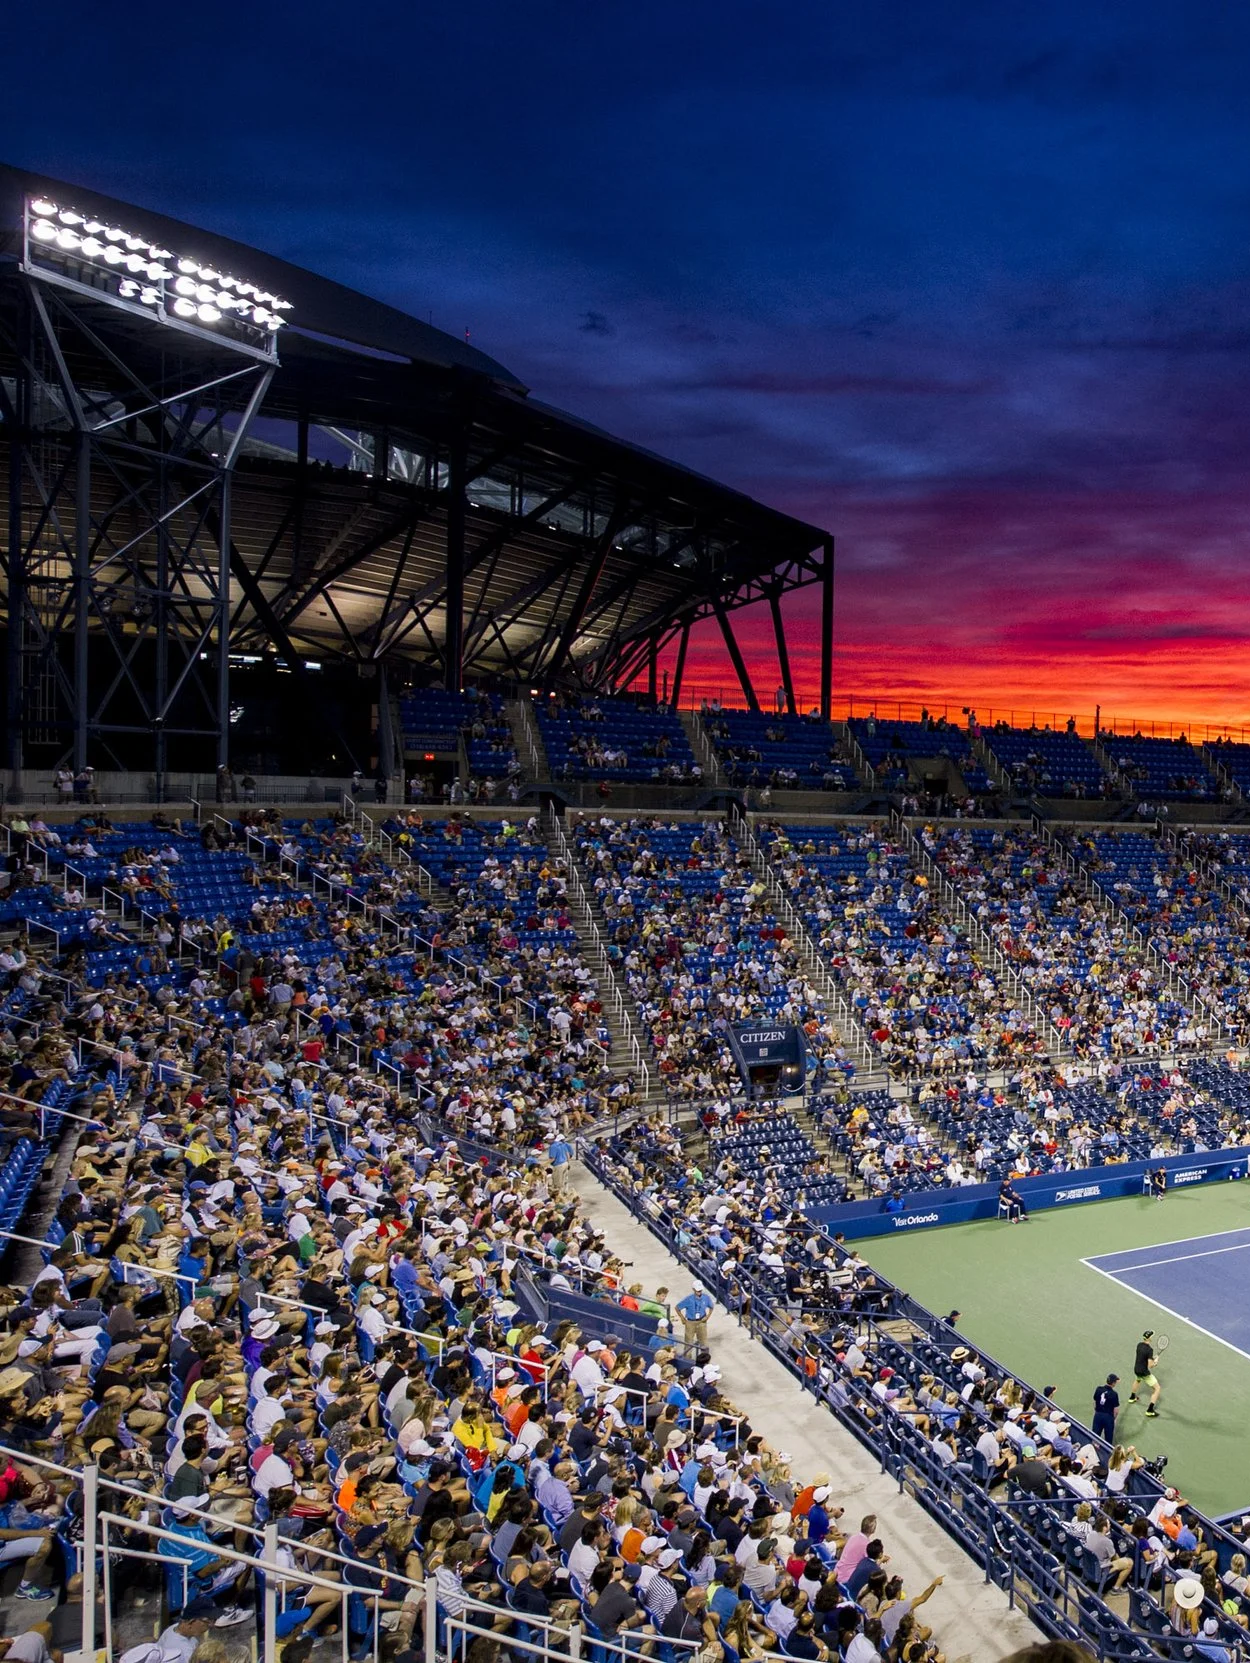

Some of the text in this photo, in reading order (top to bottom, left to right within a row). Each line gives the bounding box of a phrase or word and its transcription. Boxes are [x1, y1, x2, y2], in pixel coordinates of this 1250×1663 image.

[740, 1031, 787, 1044] CITIZEN
[1174, 1169, 1208, 1178] AMERICAN
[1174, 1175, 1202, 1184] EXPRESS
[907, 1212, 939, 1225] Orlando
